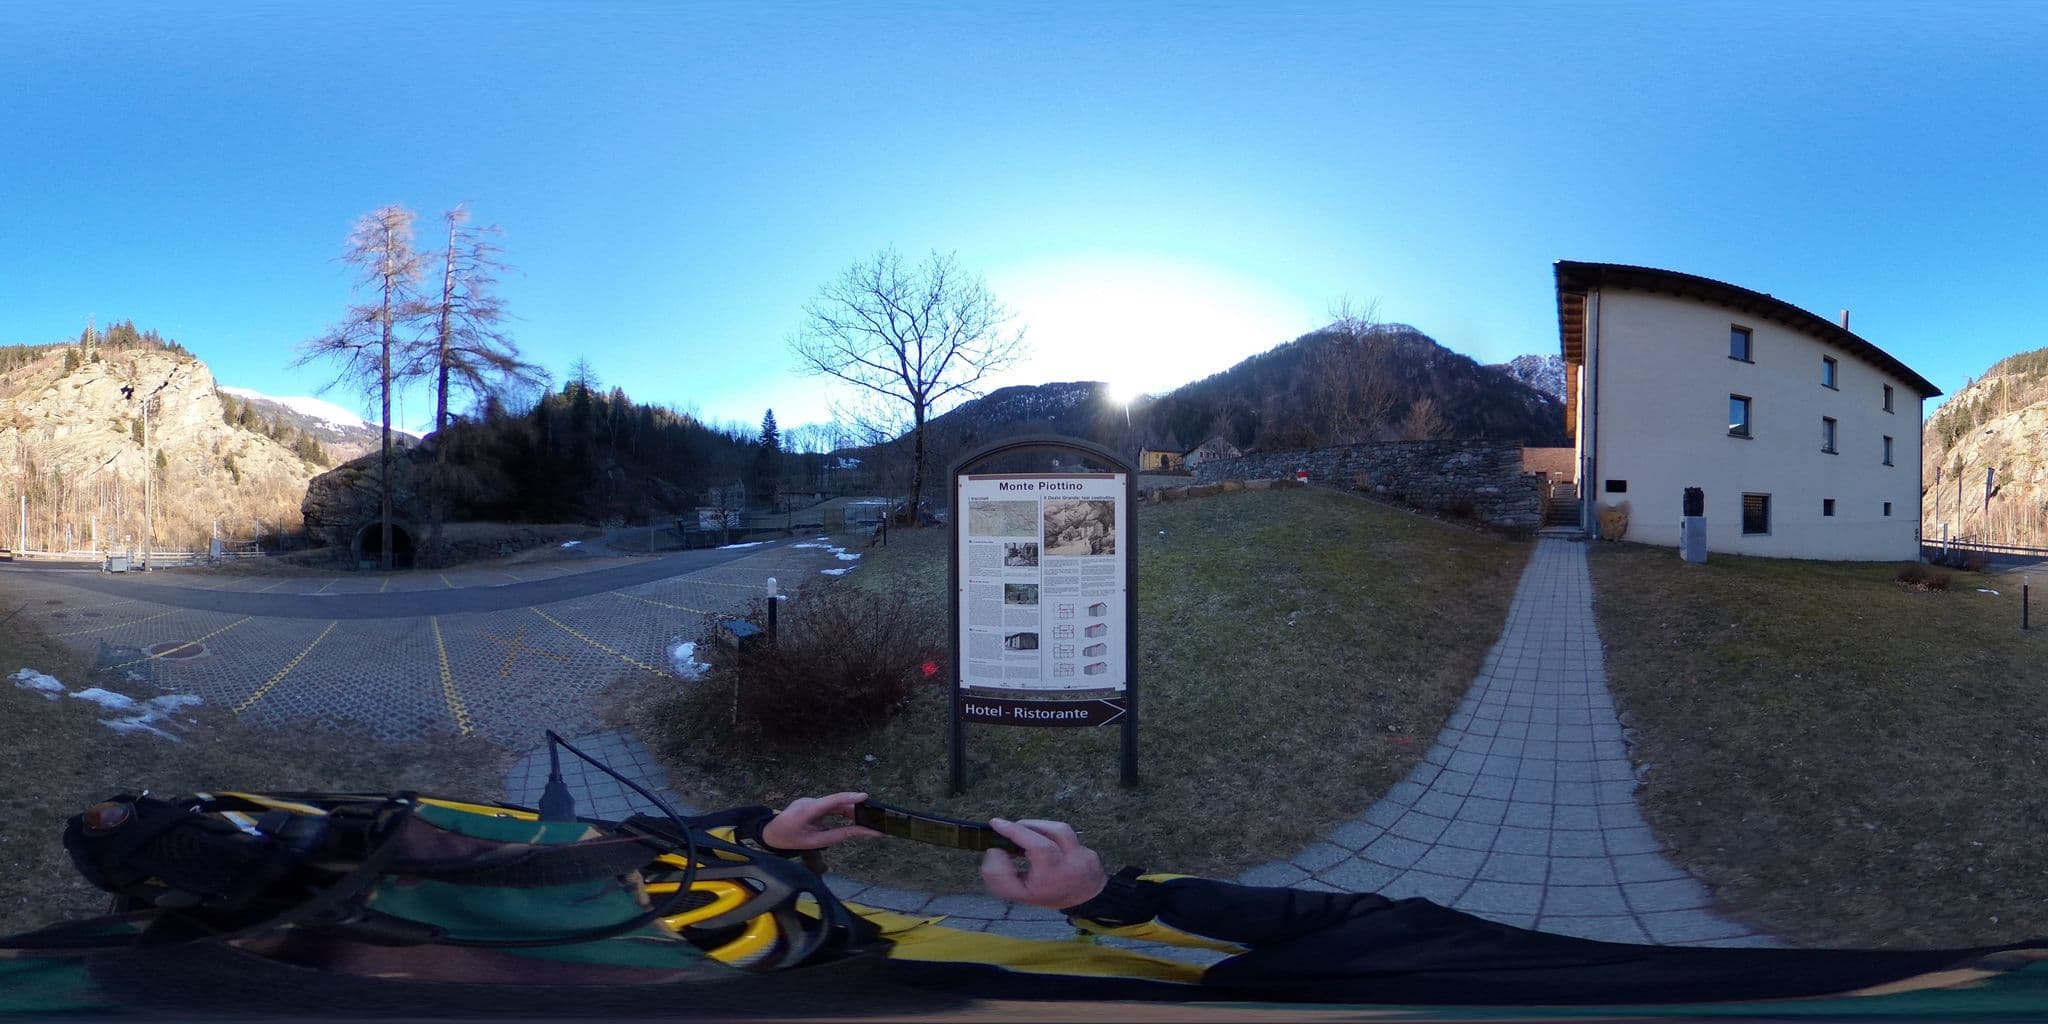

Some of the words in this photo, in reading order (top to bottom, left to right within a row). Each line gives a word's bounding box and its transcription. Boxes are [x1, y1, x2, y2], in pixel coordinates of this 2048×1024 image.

[999, 481, 1034, 491] Monte
[1038, 480, 1083, 490] Piottino
[965, 703, 1001, 717] Hotel
[1014, 707, 1088, 719] Ristorante
